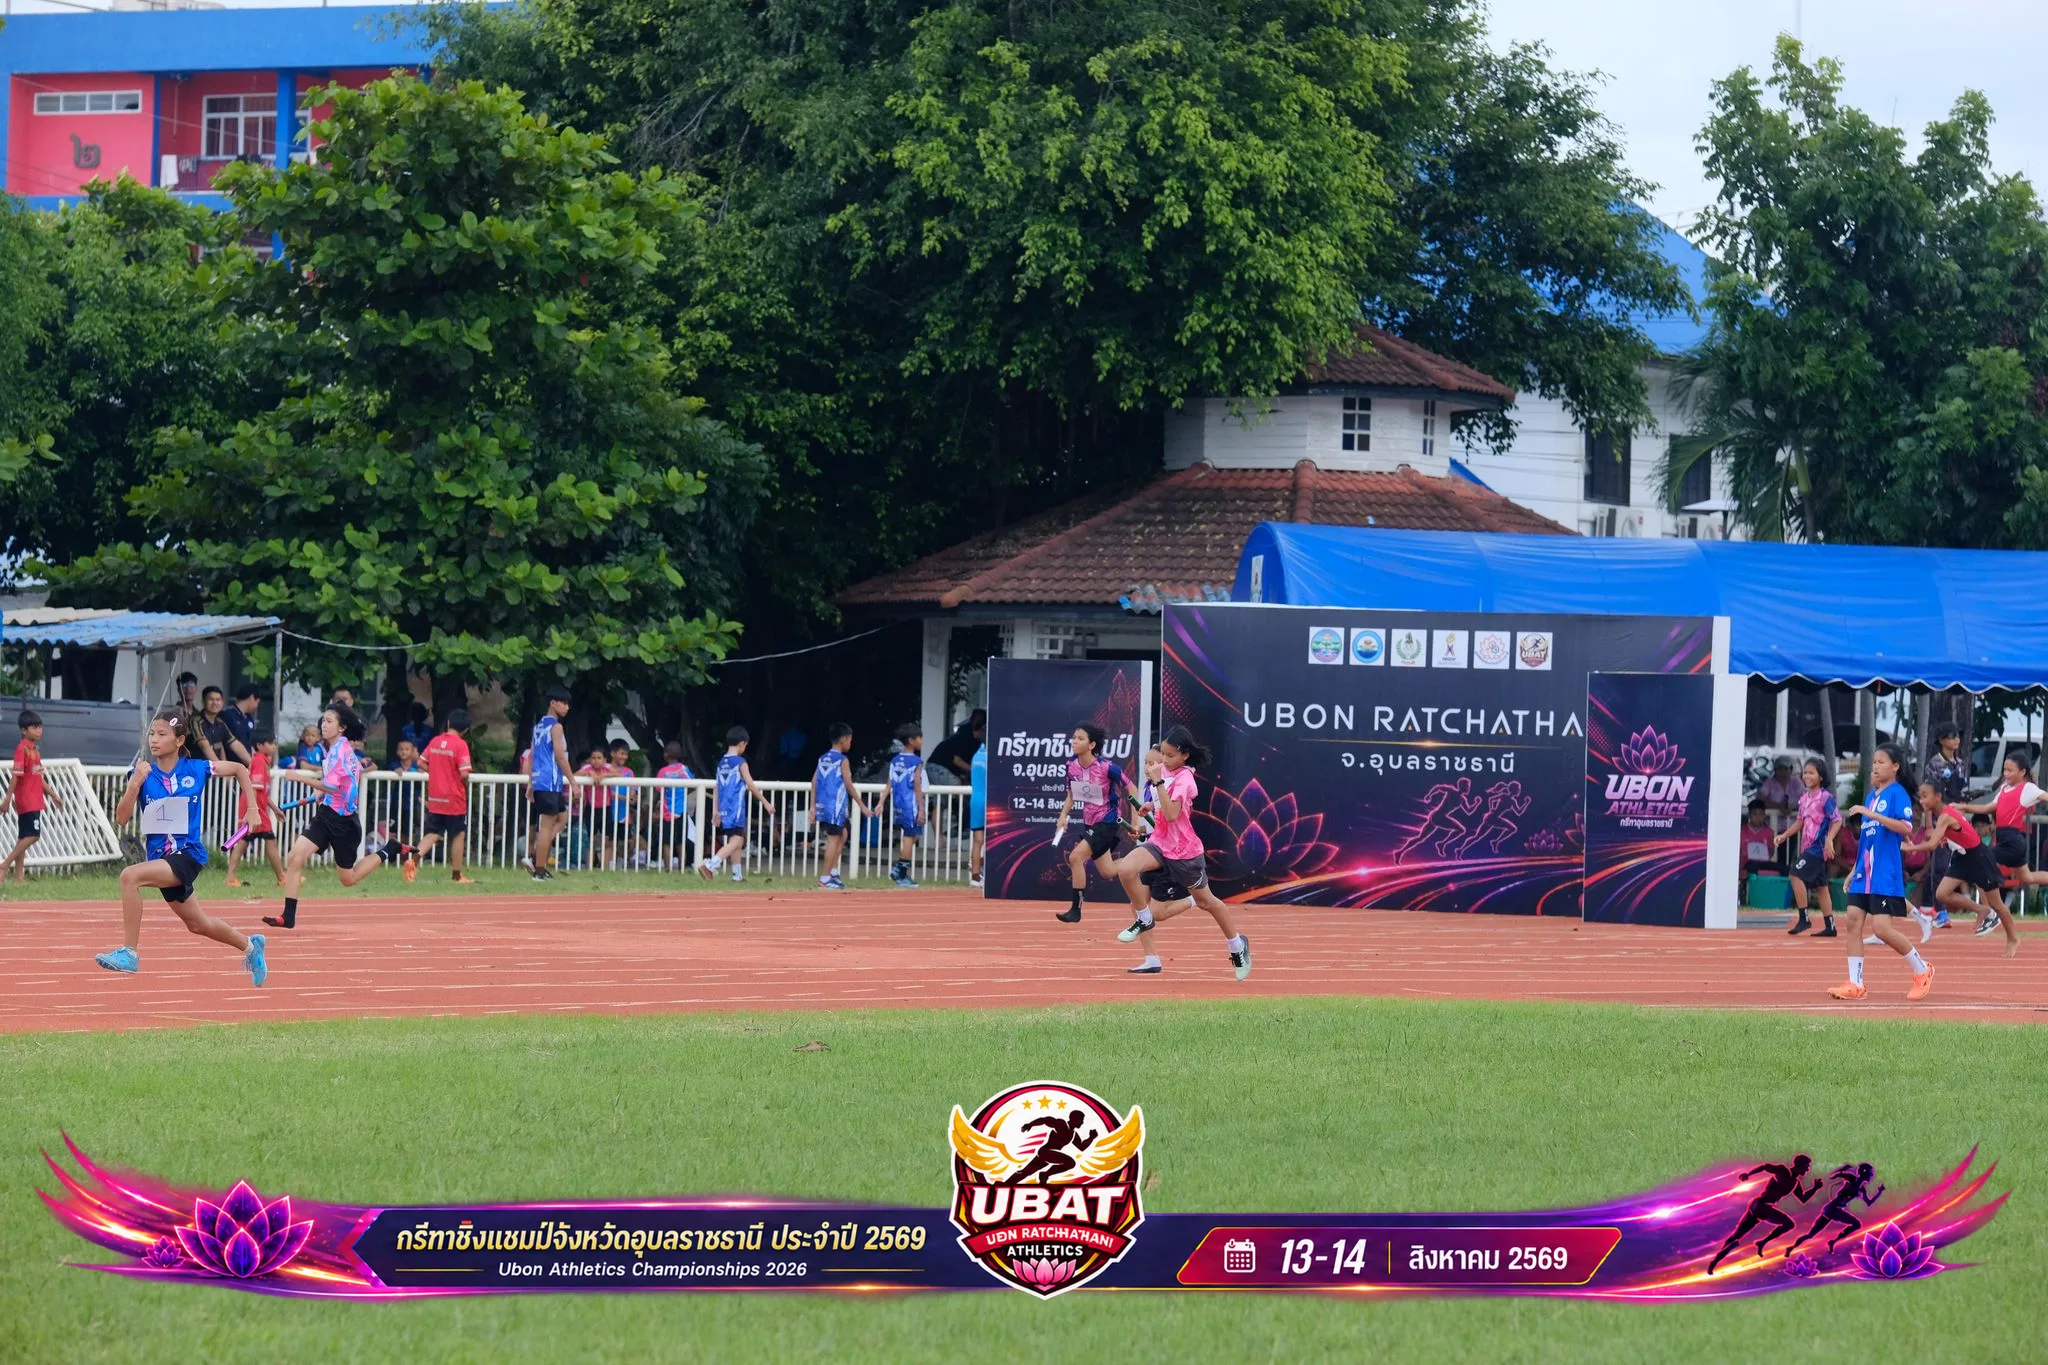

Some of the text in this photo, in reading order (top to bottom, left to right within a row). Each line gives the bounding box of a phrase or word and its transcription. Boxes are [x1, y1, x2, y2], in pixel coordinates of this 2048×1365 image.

[1243, 702, 1354, 730] UBON
[1340, 752, 1515, 776] จ.อุบลราชธานี
[1604, 774, 1695, 801] UBON
[156, 804, 174, 822] 1
[1013, 797, 1045, 809] 12-14
[1603, 801, 1689, 816] ATHLETICS
